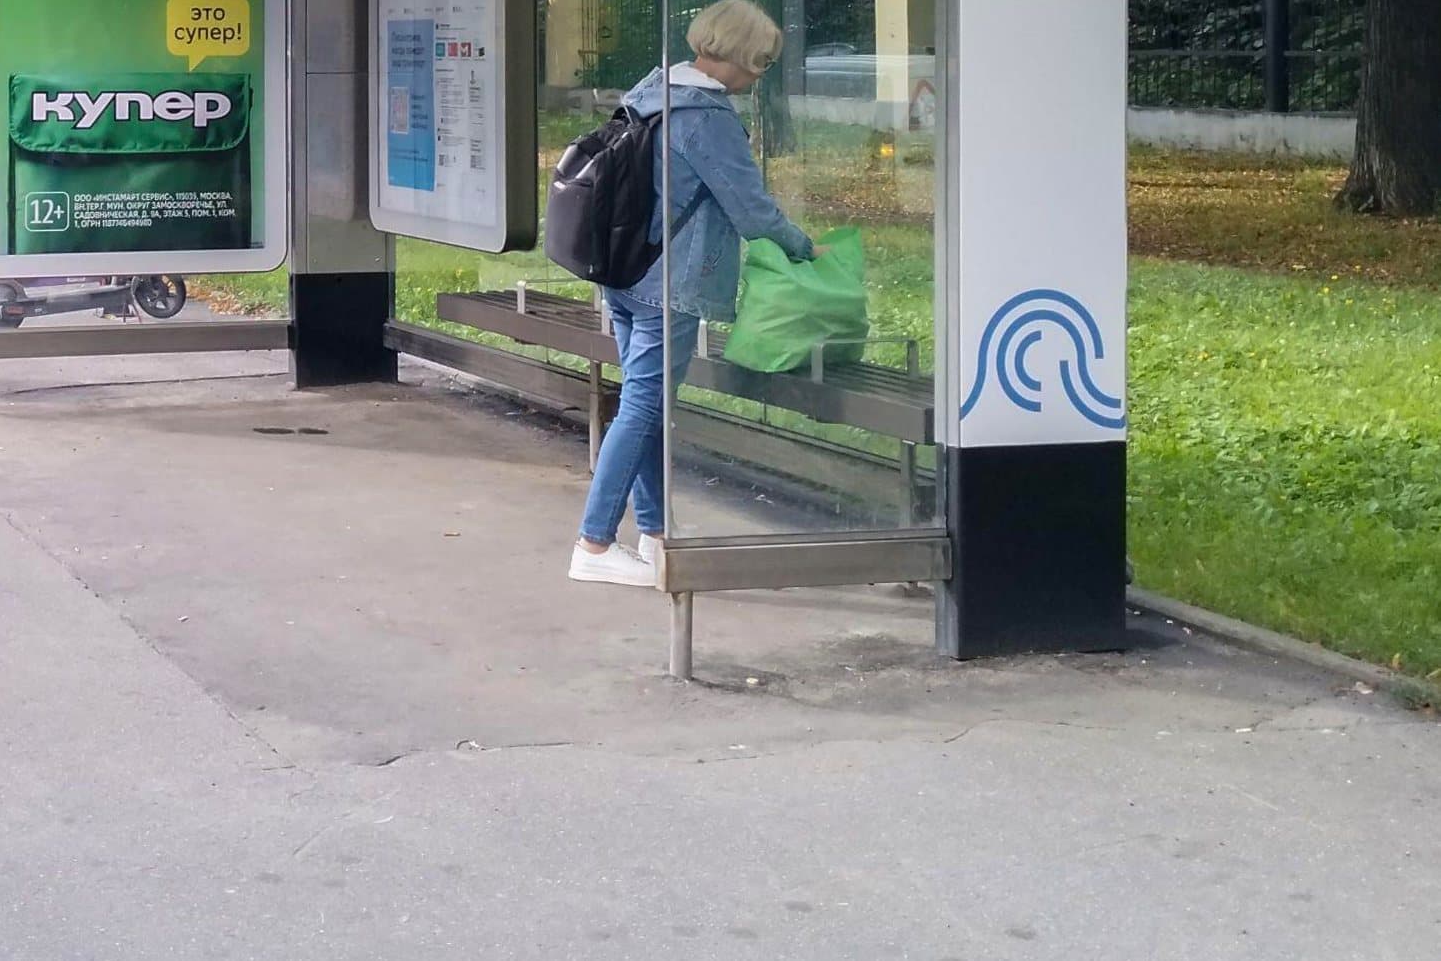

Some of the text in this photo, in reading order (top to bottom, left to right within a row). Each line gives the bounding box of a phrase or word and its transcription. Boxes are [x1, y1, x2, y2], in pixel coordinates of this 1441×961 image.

[190, 6, 226, 22] это
[174, 23, 243, 43] супер!
[30, 90, 232, 130] купер
[74, 194, 92, 202] ООО
[30, 198, 65, 225] 12+
[126, 201, 150, 210] ОКРУГ
[163, 209, 184, 218] ЭТАЖ
[80, 219, 102, 228] ОГРН
